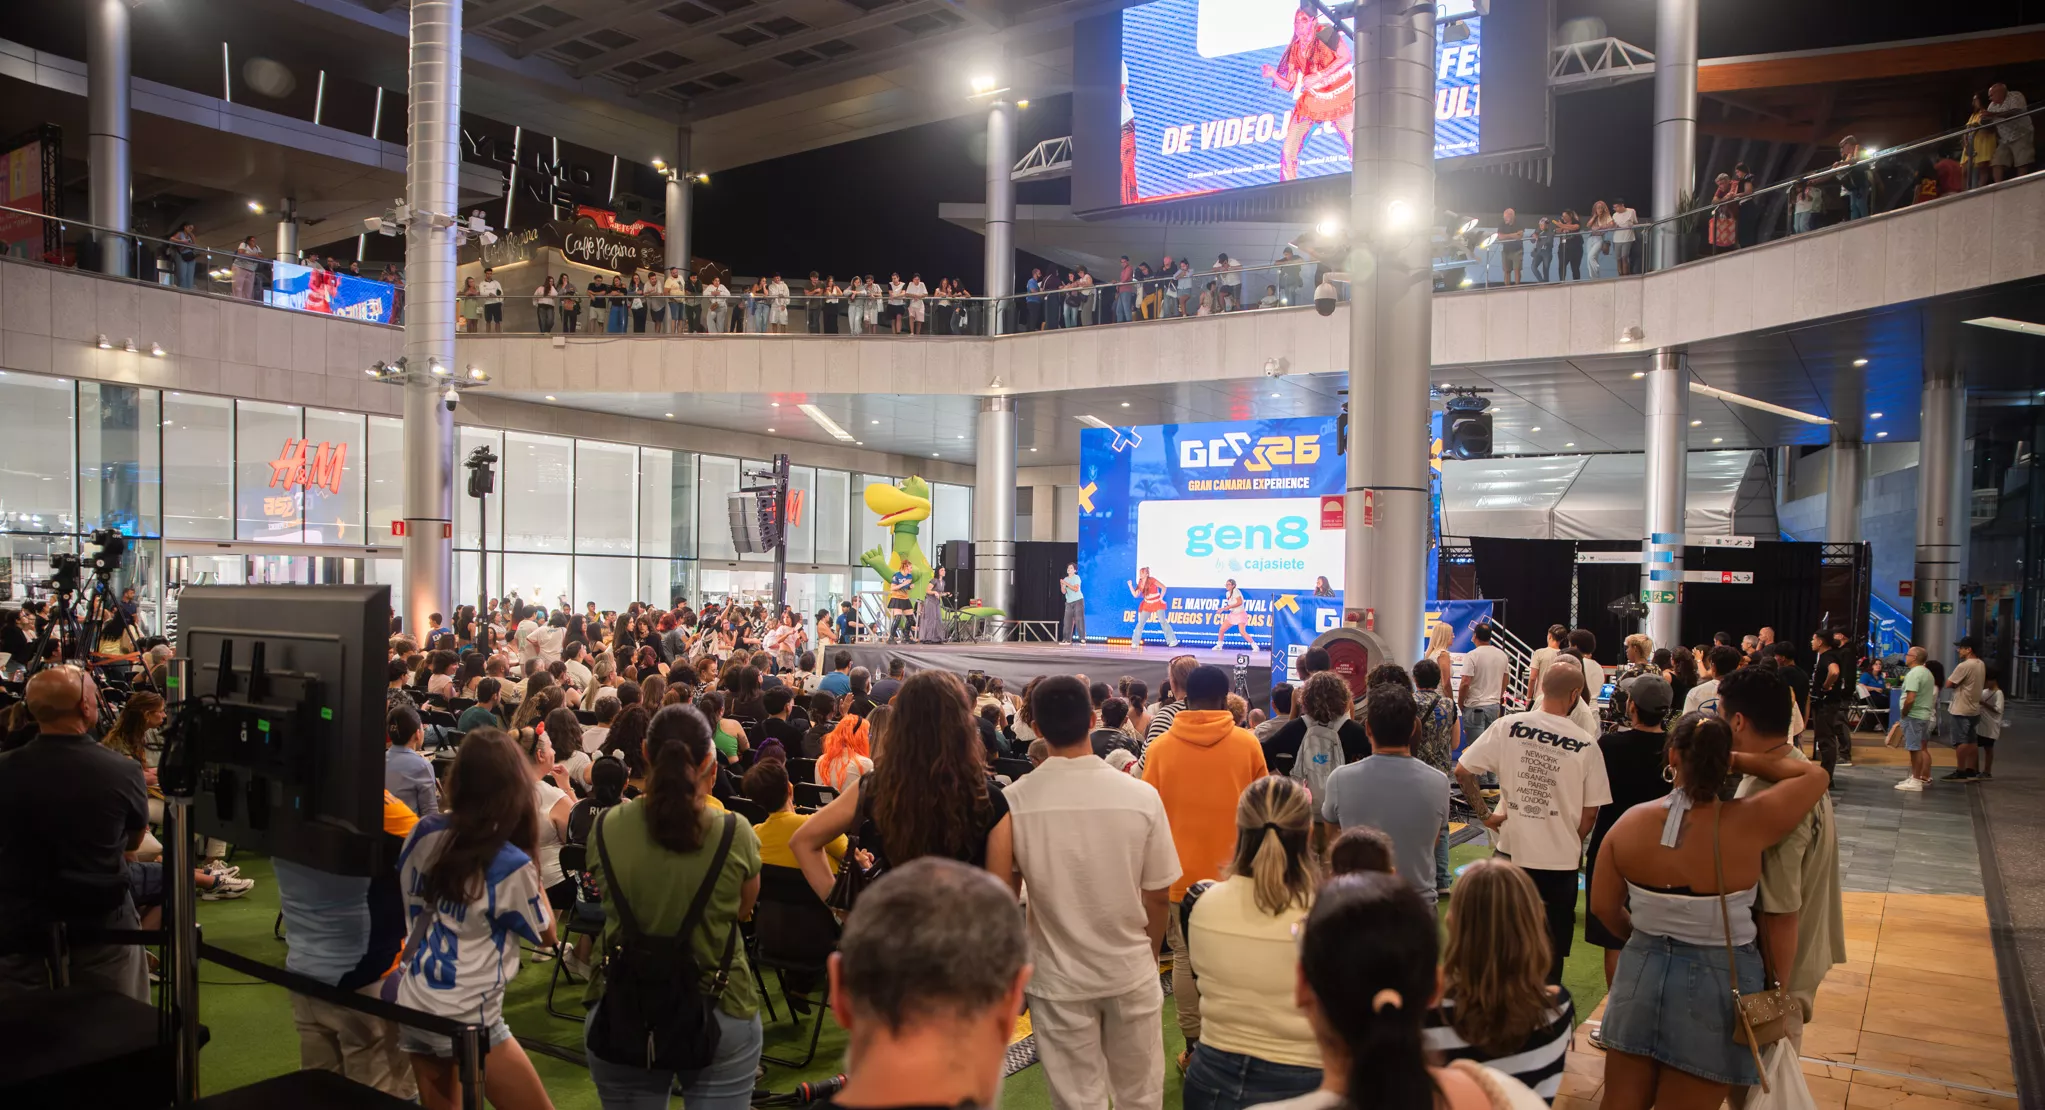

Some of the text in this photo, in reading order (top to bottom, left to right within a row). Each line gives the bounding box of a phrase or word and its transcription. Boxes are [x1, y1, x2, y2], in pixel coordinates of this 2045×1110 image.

[1162, 125, 1195, 156] DE
[565, 232, 637, 269] Café Regina
[268, 438, 347, 494] H&M
[1188, 477, 1310, 491] GRAN CANARIA EXPERIENCE
[1185, 515, 1309, 557] gen8
[1244, 558, 1305, 572] cajasiete
[1171, 598, 1182, 609] EL
[1185, 598, 1220, 611] MAYOR
[1123, 610, 1136, 622] DE
[1205, 613, 1212, 625] Y
[1517, 771, 1530, 779] LOS
[1528, 780, 1548, 791] PARIS
[1521, 795, 1549, 806] LONDON
